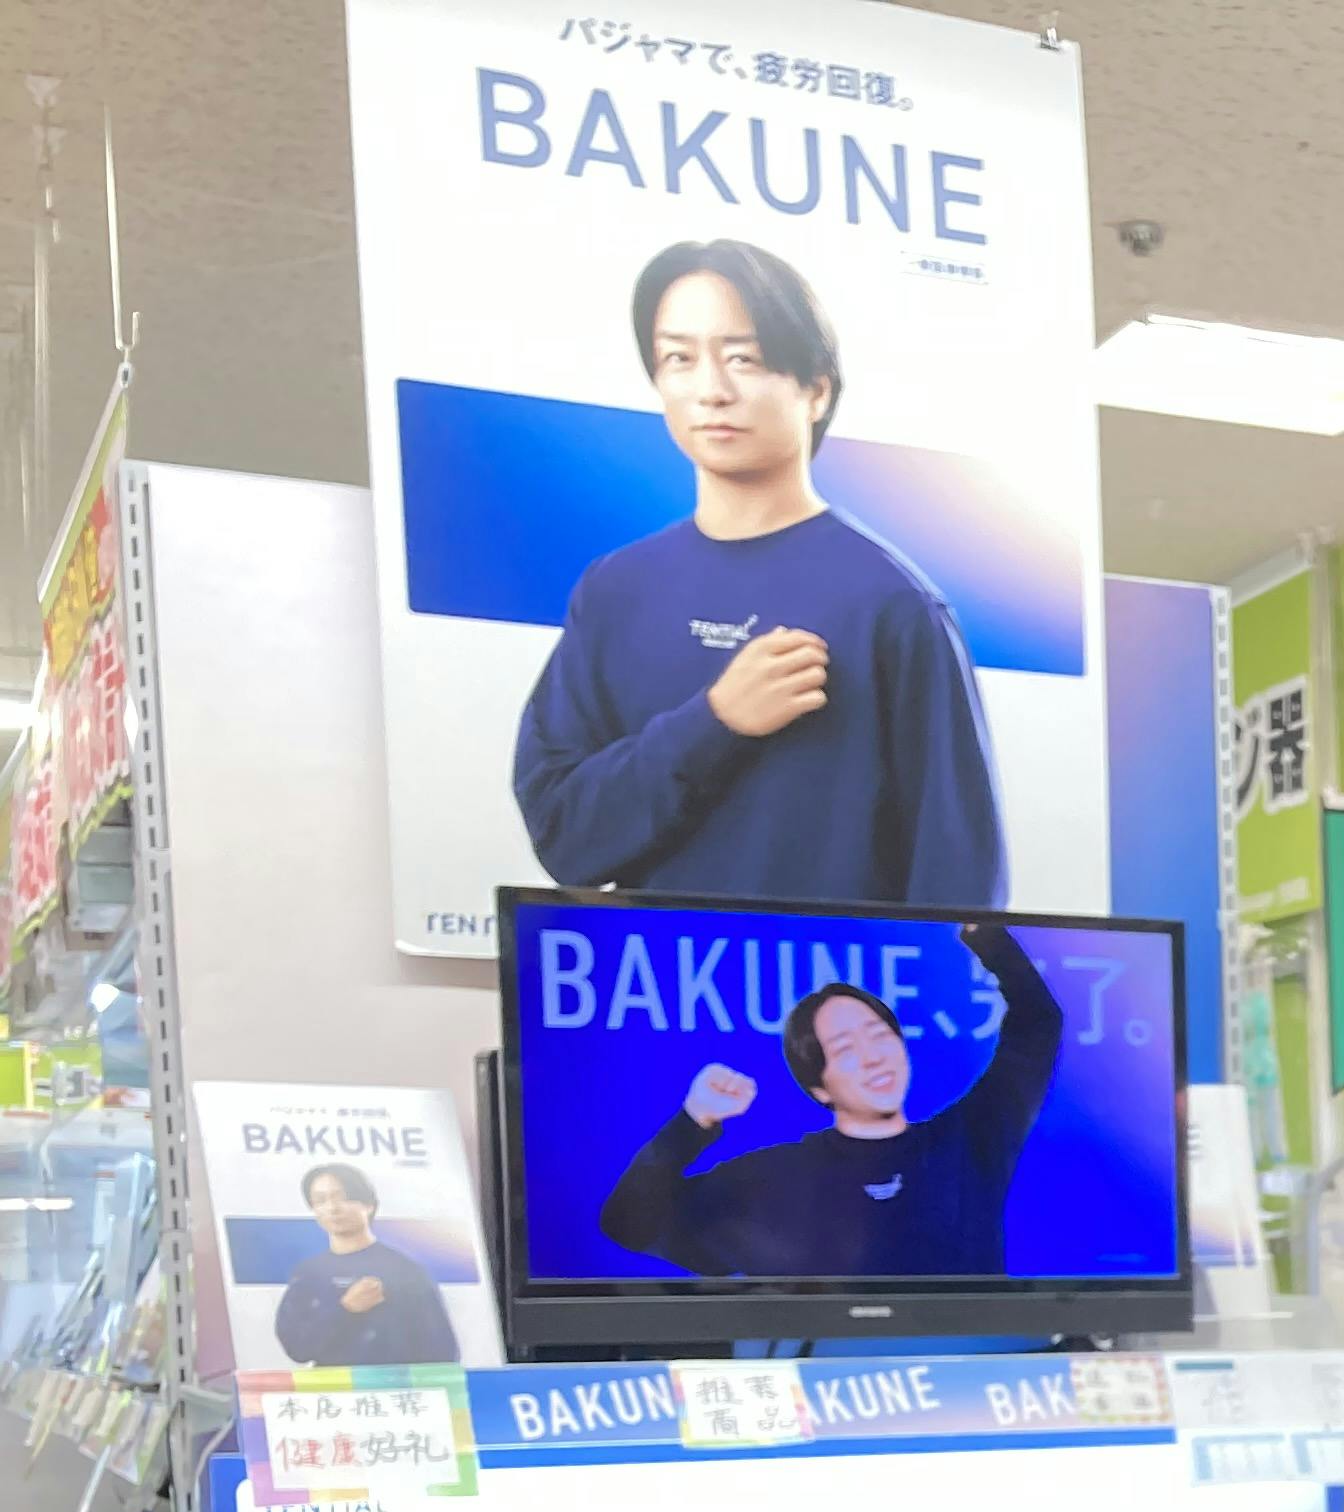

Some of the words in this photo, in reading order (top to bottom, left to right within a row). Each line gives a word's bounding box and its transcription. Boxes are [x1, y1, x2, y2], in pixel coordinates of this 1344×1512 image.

[559, 17, 914, 111] パジャマで、疲労回復。
[475, 66, 988, 246] BAKUNE
[241, 1123, 428, 1157] BAKUNE
[275, 1390, 431, 1421] 本店推荐
[701, 1405, 799, 1439] 商品
[274, 1430, 452, 1475] 健康好礼
